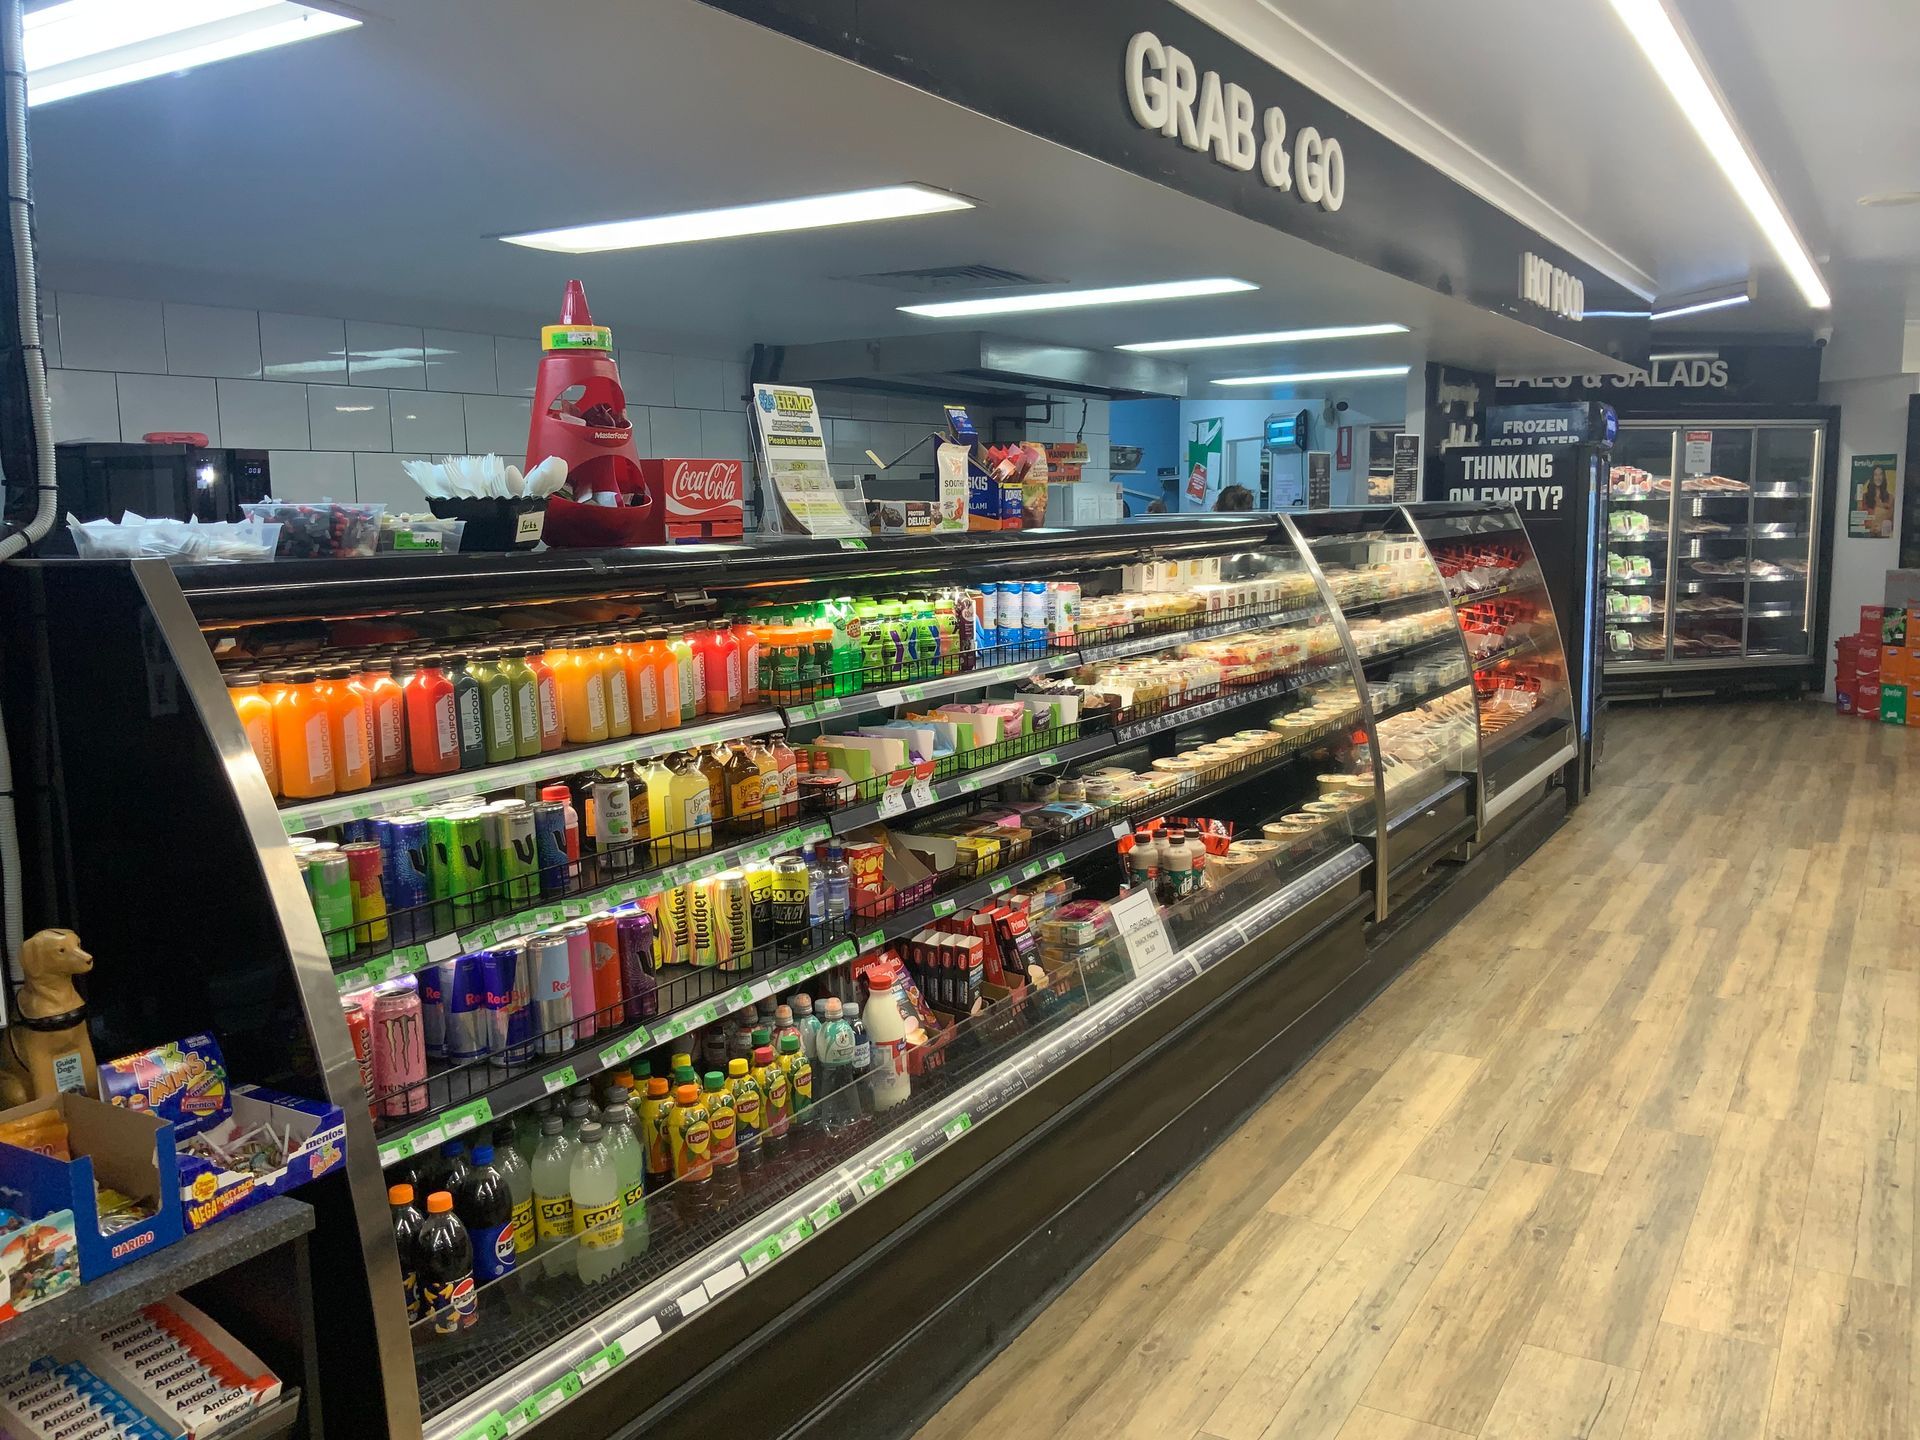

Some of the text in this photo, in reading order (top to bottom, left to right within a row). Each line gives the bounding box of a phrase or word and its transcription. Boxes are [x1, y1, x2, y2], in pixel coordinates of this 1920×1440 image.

[1124, 30, 1345, 212] GRAB & GO
[1520, 251, 1585, 322] HOT FOOD
[1610, 359, 1729, 388] SALADS
[776, 395, 813, 412] HEMP
[1502, 418, 1568, 434] FROZEN
[1461, 454, 1554, 480] THINKING
[1481, 486, 1564, 511] EMPTY?
[907, 516, 931, 526] DELUXE
[424, 538, 440, 548] 50c
[447, 694, 458, 747] YOUFOODZ
[471, 688, 480, 740] YOUFOODZ
[503, 686, 511, 736] YOUFOODZ
[1010, 918, 1026, 932] Primo
[426, 986, 441, 999] Re
[466, 993, 482, 1006] Re
[56, 1058, 77, 1068] Guide
[186, 1100, 216, 1110] mentos
[738, 1101, 759, 1112] Lipton
[690, 1130, 708, 1143] Lipton
[714, 1118, 734, 1130] Lipton
[305, 1128, 344, 1150] mentos
[626, 1186, 642, 1204] SO
[190, 1202, 218, 1230] MEGA
[512, 1208, 534, 1228] SOL
[544, 1202, 572, 1219] SOL
[112, 1230, 155, 1259] HARIBO
[660, 1303, 678, 1318] CEDA
[100, 1318, 142, 1342] Anticol
[112, 1326, 153, 1351] Anticol
[124, 1335, 164, 1360] Anticol
[134, 1344, 176, 1370] Anticol
[144, 1354, 184, 1380] Anticol
[156, 1364, 196, 1390] Anticol
[8, 1373, 52, 1400] Anticol
[18, 1383, 62, 1410] Anticol
[166, 1373, 207, 1400] Anticol
[176, 1384, 216, 1411] Anticol
[31, 1392, 74, 1420] Anticol
[202, 1388, 244, 1415] Anticol
[43, 1402, 87, 1431] Anticol
[54, 1412, 98, 1440] Anticol
